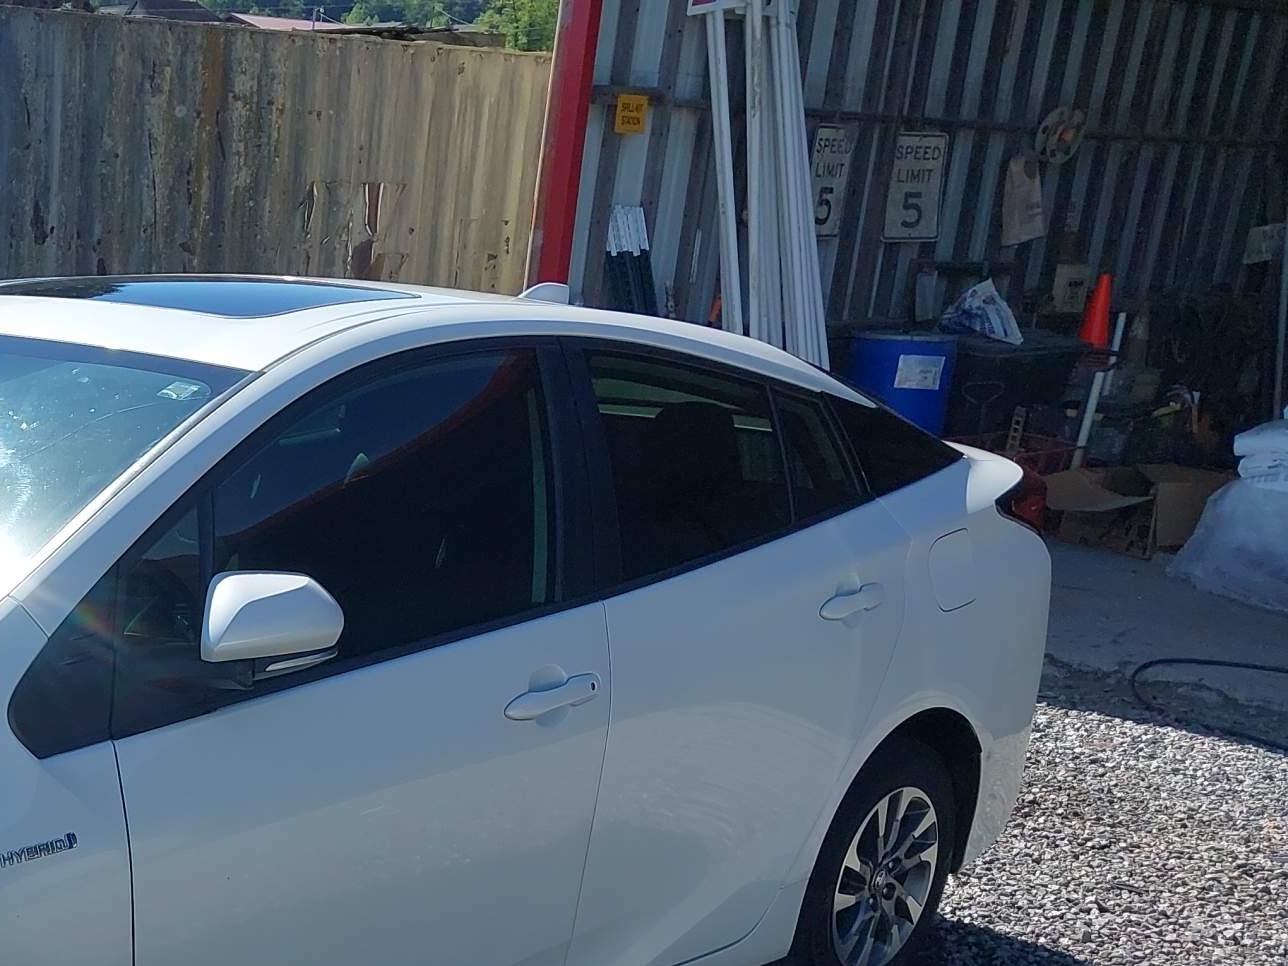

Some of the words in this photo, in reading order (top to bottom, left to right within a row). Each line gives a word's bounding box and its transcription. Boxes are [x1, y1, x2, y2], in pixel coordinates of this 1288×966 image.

[816, 138, 853, 155] SPEED
[895, 145, 942, 161] SPEED
[815, 162, 845, 178] LIMIT
[896, 168, 934, 184] LIMIT
[900, 191, 923, 229] 5
